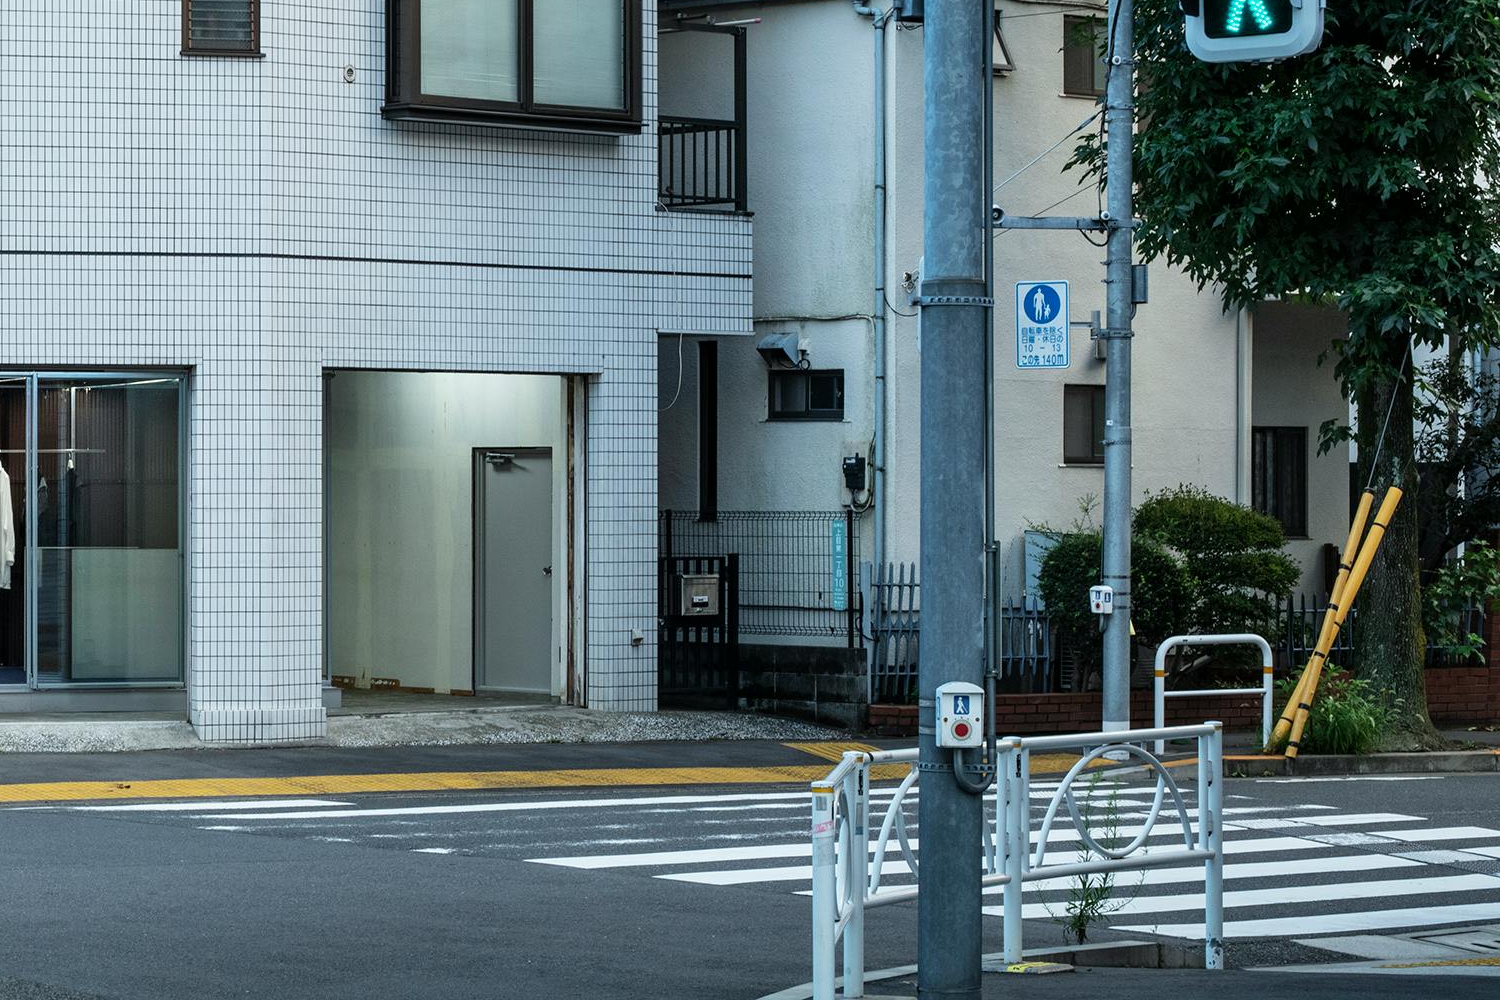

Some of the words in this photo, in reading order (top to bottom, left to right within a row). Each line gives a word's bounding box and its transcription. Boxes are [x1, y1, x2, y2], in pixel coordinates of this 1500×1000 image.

[1024, 344, 1034, 352] 10
[1052, 343, 1061, 352] 13
[1022, 354, 1040, 365] この先
[1042, 354, 1064, 365] 140m
